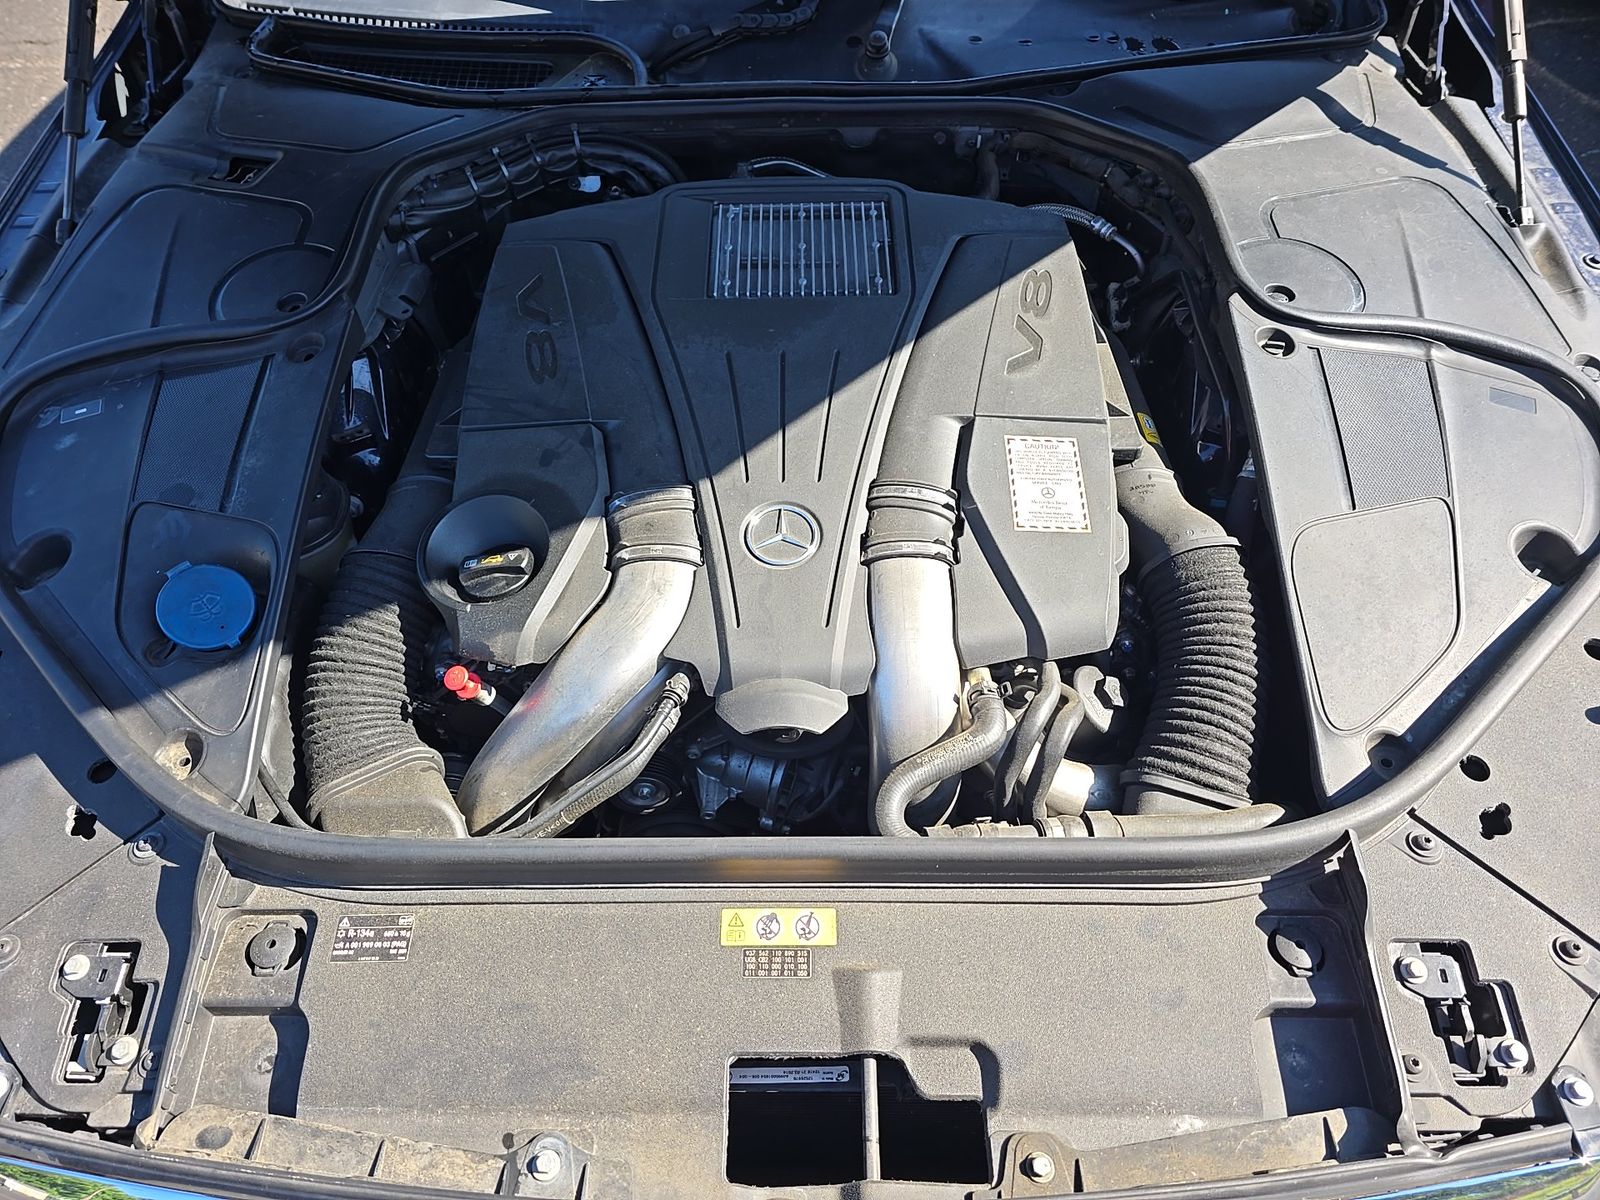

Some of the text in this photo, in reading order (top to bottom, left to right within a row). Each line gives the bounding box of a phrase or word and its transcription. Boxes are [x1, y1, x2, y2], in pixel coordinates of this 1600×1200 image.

[516, 273, 558, 384] V8
[1004, 268, 1053, 375] V8
[348, 929, 375, 937] R-134a
